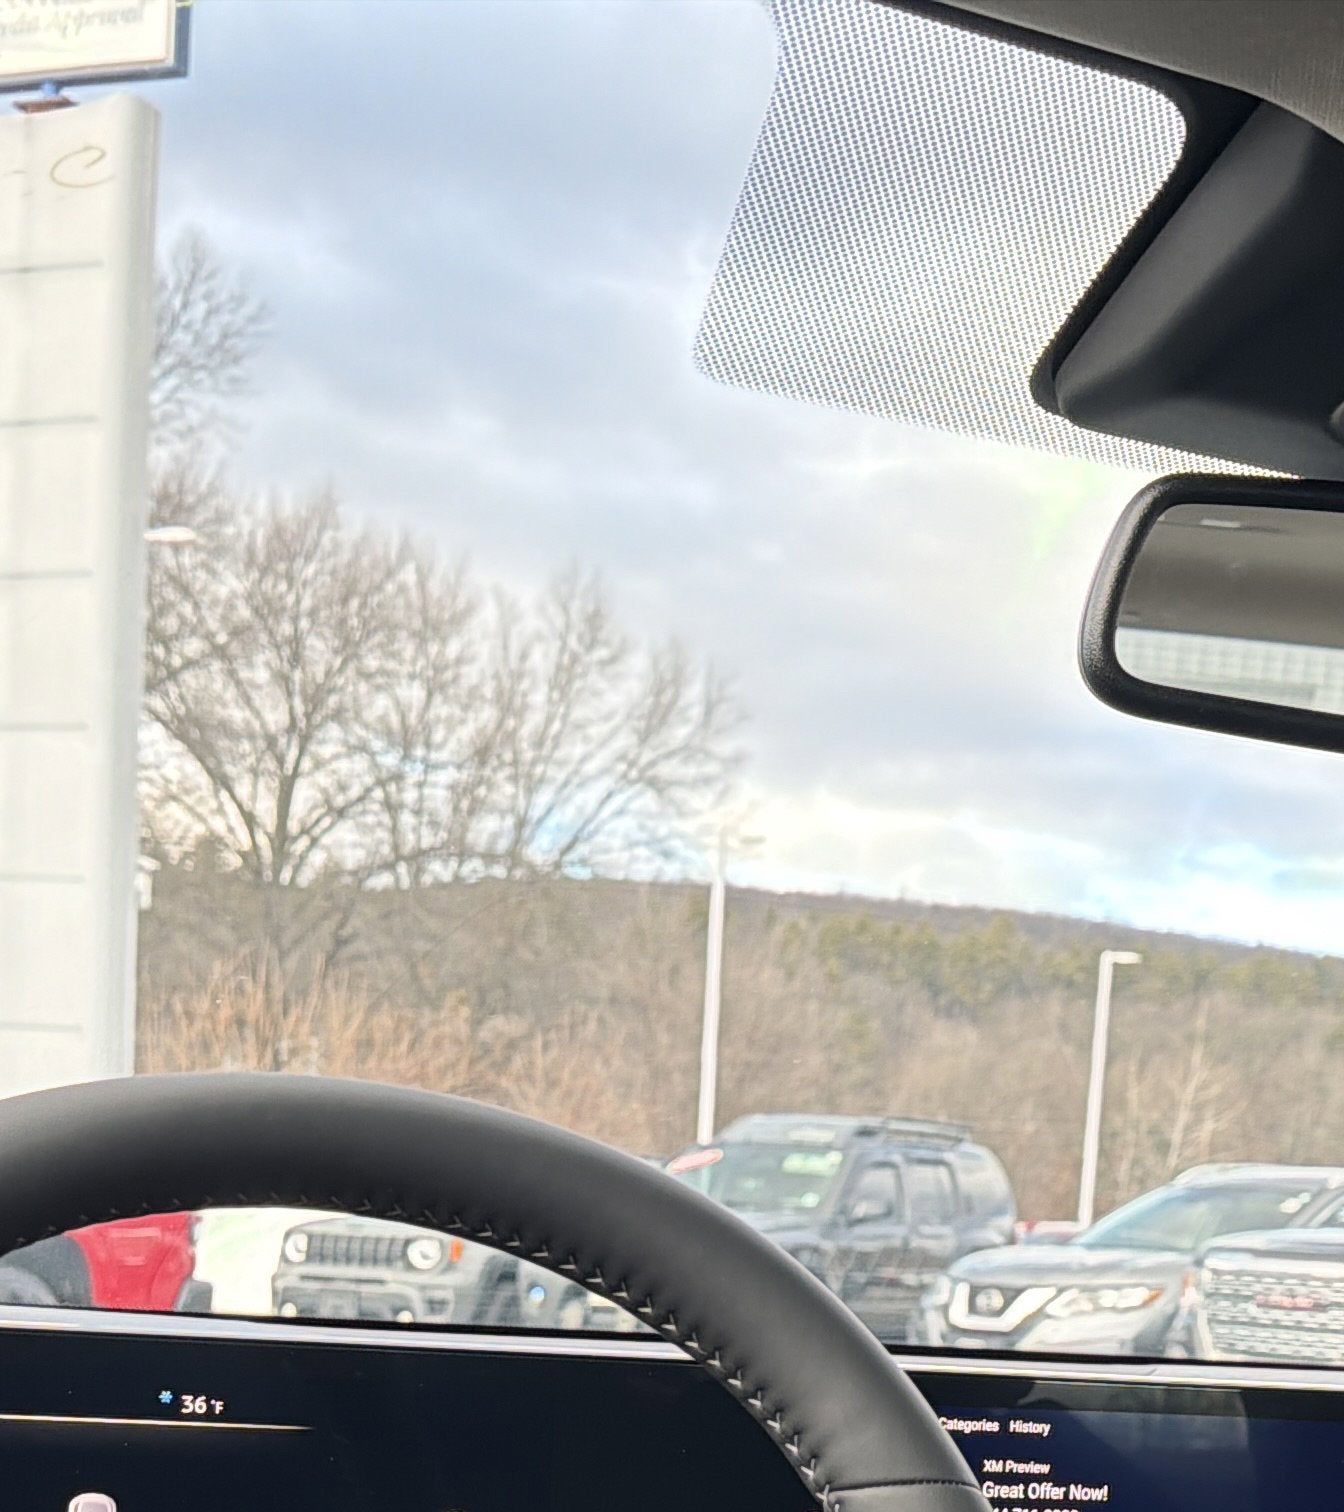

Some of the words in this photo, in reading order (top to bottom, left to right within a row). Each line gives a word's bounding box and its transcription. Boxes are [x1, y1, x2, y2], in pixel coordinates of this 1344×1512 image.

[180, 1395, 206, 1414] 36
[939, 1417, 1000, 1433] Categories
[1010, 1420, 1050, 1436] History
[982, 1460, 1003, 1472] XM
[1006, 1460, 1050, 1474] Preview
[982, 1481, 1025, 1498] Great
[1028, 1483, 1064, 1499] Offer
[1068, 1485, 1108, 1501] Now!
